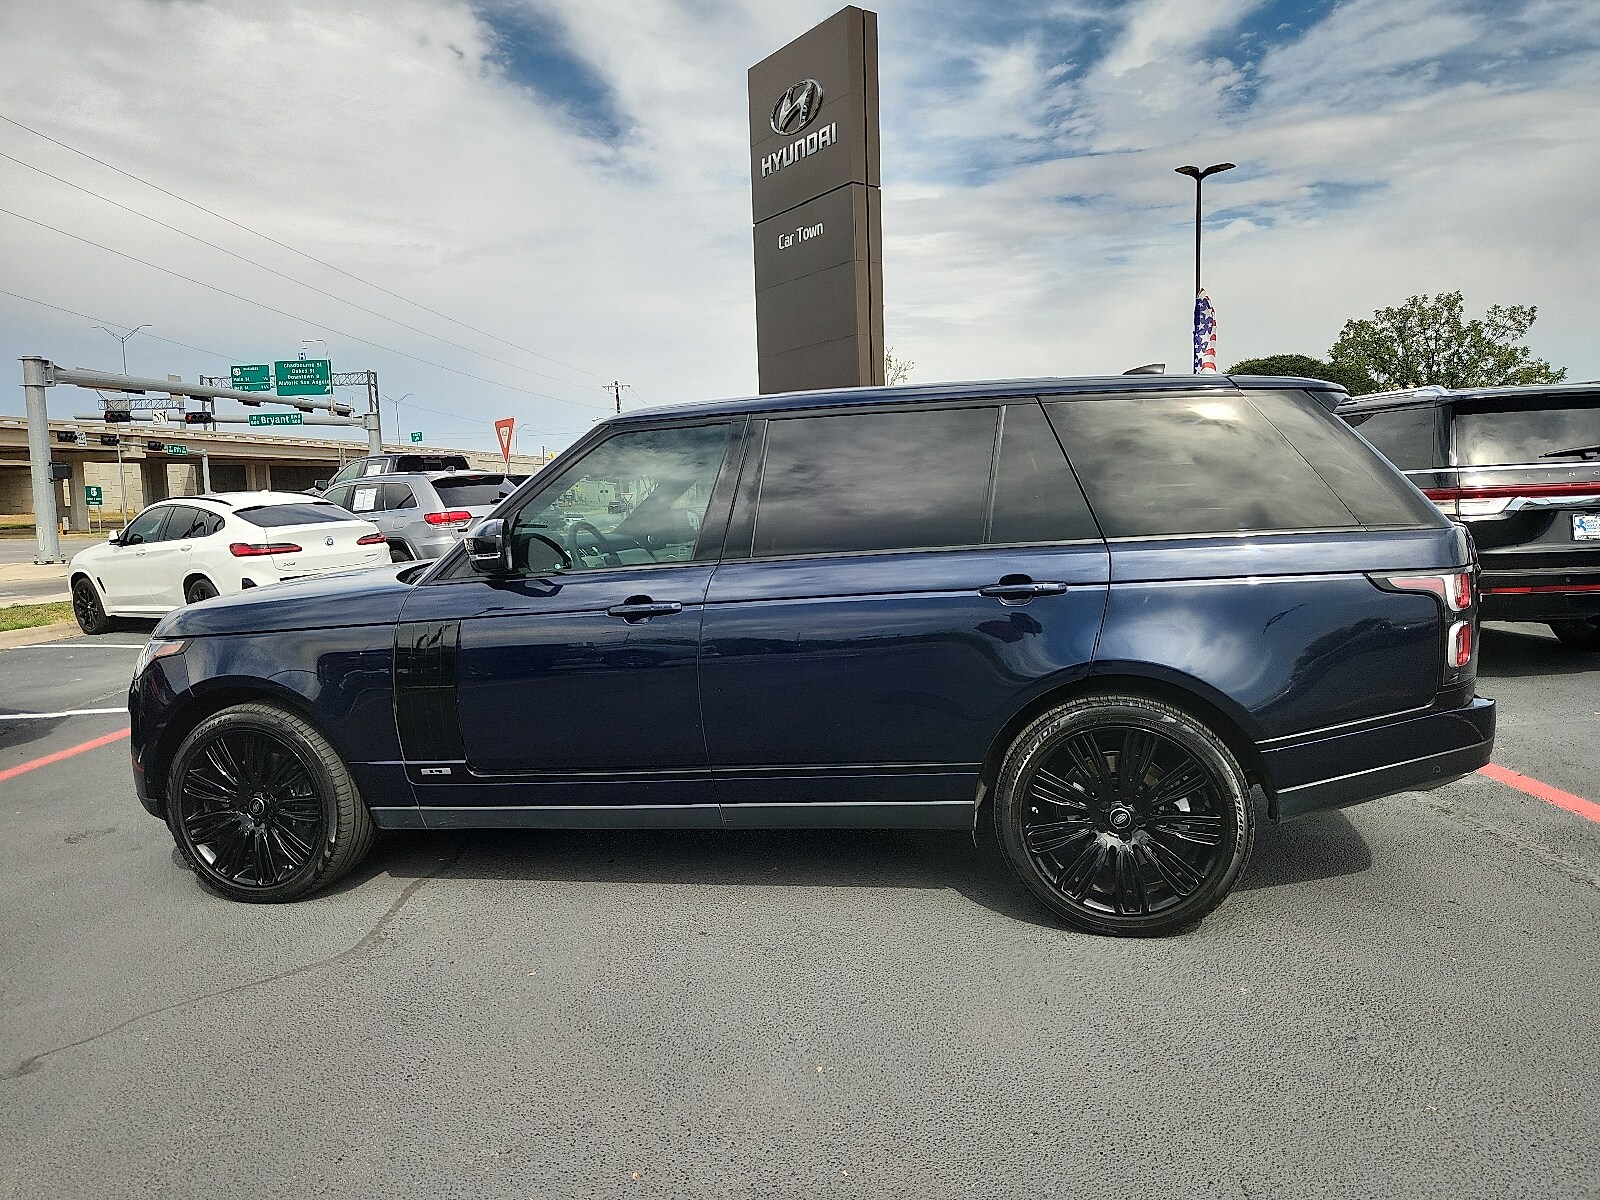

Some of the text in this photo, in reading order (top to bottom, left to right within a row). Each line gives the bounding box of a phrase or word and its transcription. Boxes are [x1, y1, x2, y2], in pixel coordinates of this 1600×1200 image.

[761, 121, 838, 178] HYUNDAI
[778, 222, 824, 250] Car Town
[260, 415, 290, 426] Bryant
